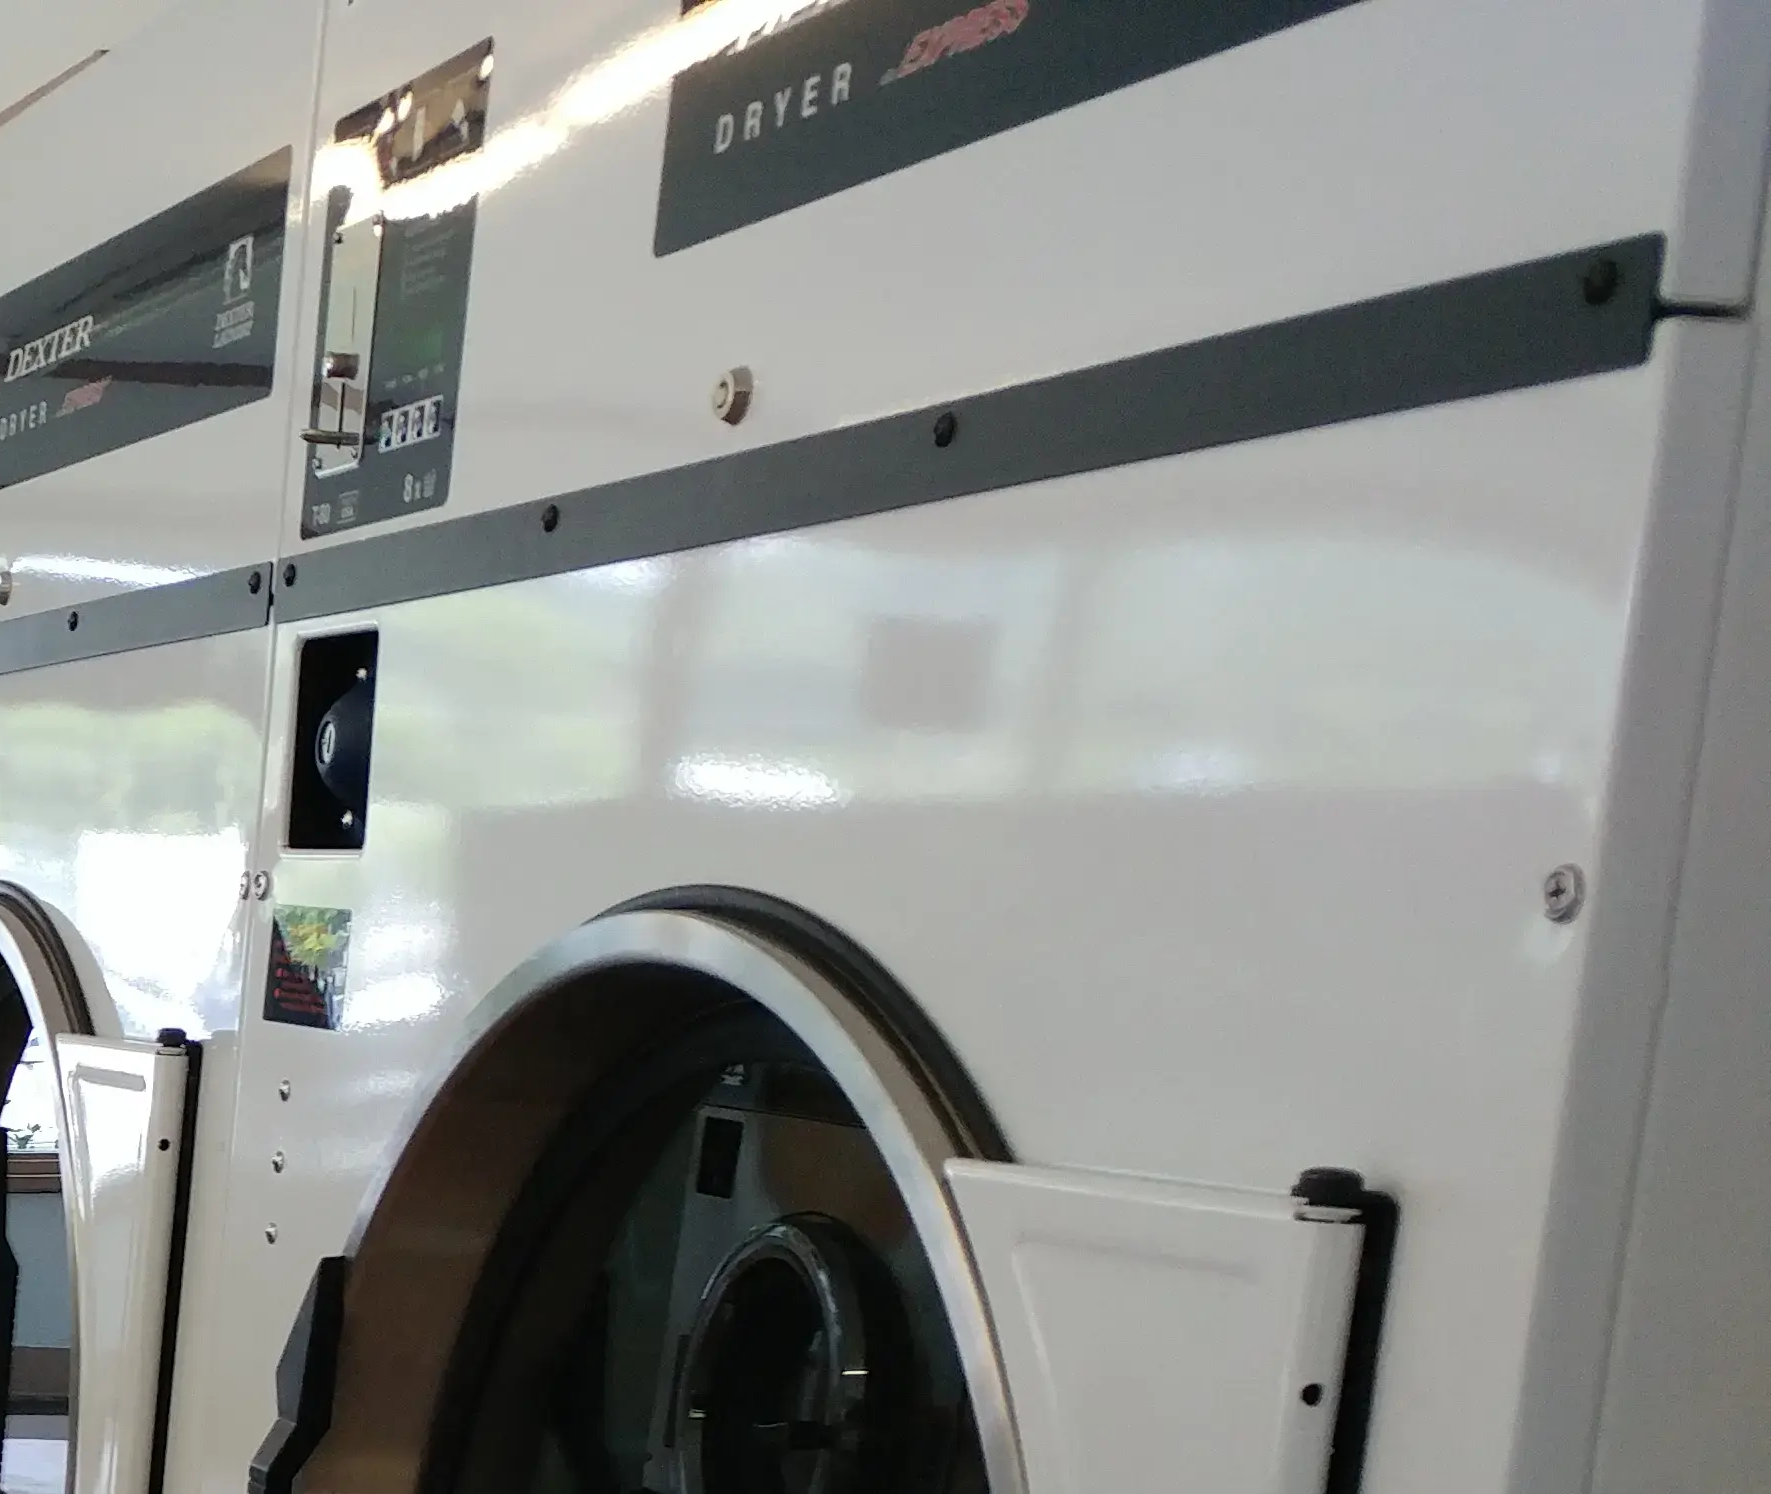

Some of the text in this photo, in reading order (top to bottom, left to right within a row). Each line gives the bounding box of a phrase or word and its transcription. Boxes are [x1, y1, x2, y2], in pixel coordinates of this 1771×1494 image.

[713, 61, 853, 154] DRYER
[3, 314, 94, 383] DEXTER
[0, 400, 48, 441] DRYER
